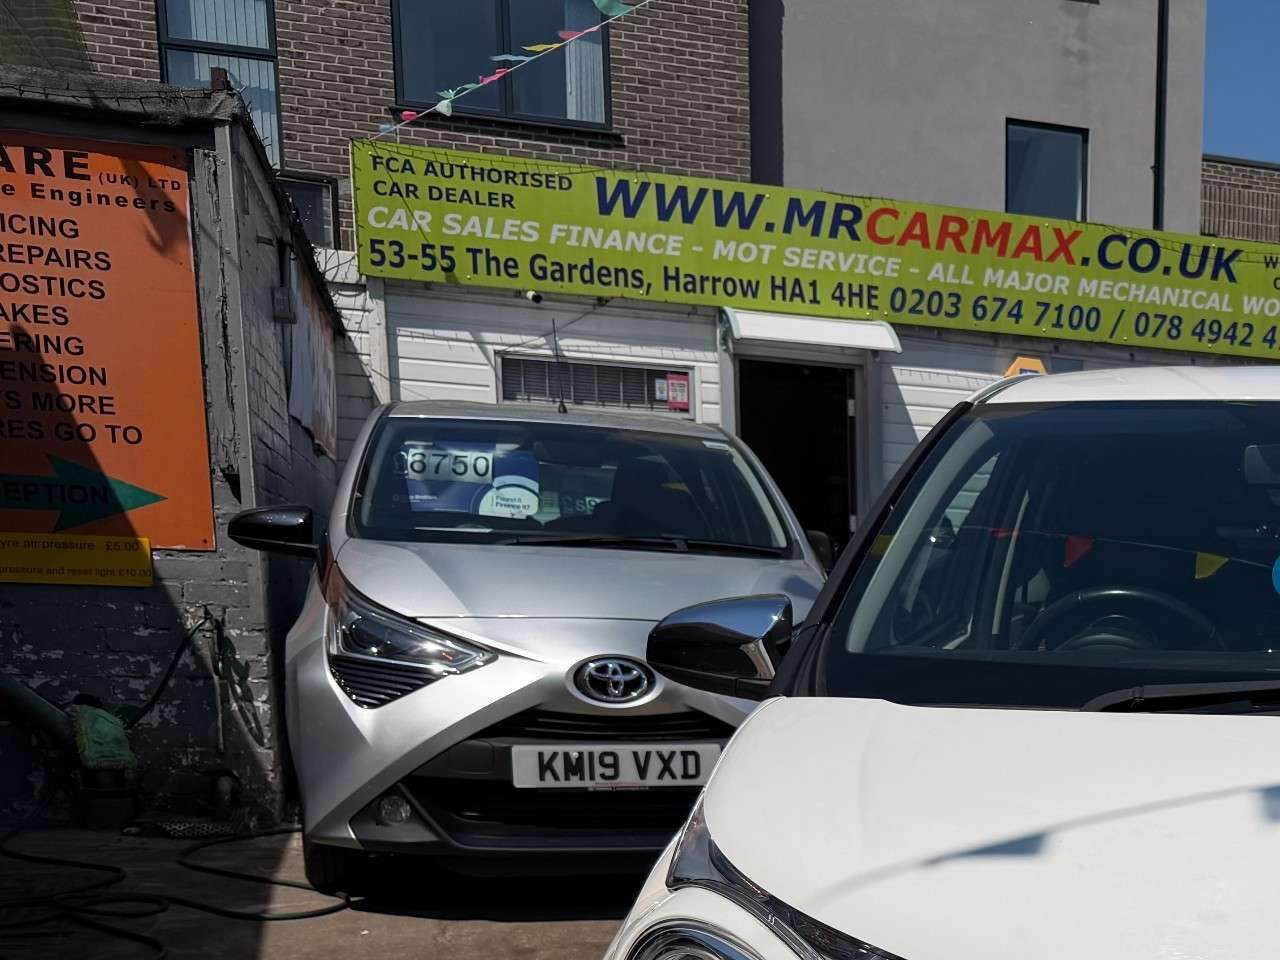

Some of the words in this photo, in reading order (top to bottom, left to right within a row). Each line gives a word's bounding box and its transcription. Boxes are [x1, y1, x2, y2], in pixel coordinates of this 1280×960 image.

[98, 172, 139, 188] (UK)
[148, 178, 181, 191] LTD
[371, 155, 416, 176] FCA
[423, 162, 573, 191] AUTHORISED
[30, 182, 176, 213] Engineers
[373, 180, 419, 200] CAR
[428, 185, 516, 209] DEALER
[596, 176, 1243, 283] WWW.MRCARMAX.CO.UK
[367, 206, 433, 234] CAR
[441, 213, 541, 243] SALES
[548, 223, 683, 256] FINANCE
[711, 240, 776, 264] MOT
[782, 246, 901, 278] SERVICE
[928, 262, 974, 286] ALL
[983, 268, 1071, 295] MAJOR
[1077, 278, 1234, 313] MECHANICAL
[369, 238, 457, 274] 53-55
[465, 246, 519, 279] The
[529, 253, 653, 297] Gardens,
[663, 265, 761, 300] Harrow
[769, 276, 819, 305] HA1
[831, 281, 880, 311] 4HE
[889, 286, 962, 319] 0203
[972, 295, 1024, 324] 674
[1034, 301, 1100, 333] 7100
[1133, 312, 1182, 341] 078
[1191, 318, 1255, 348] 4942
[32, 391, 116, 415] MORE
[54, 422, 96, 442] GO
[105, 424, 143, 445] TO
[537, 751, 620, 782] KM19
[632, 750, 701, 780] VXD
